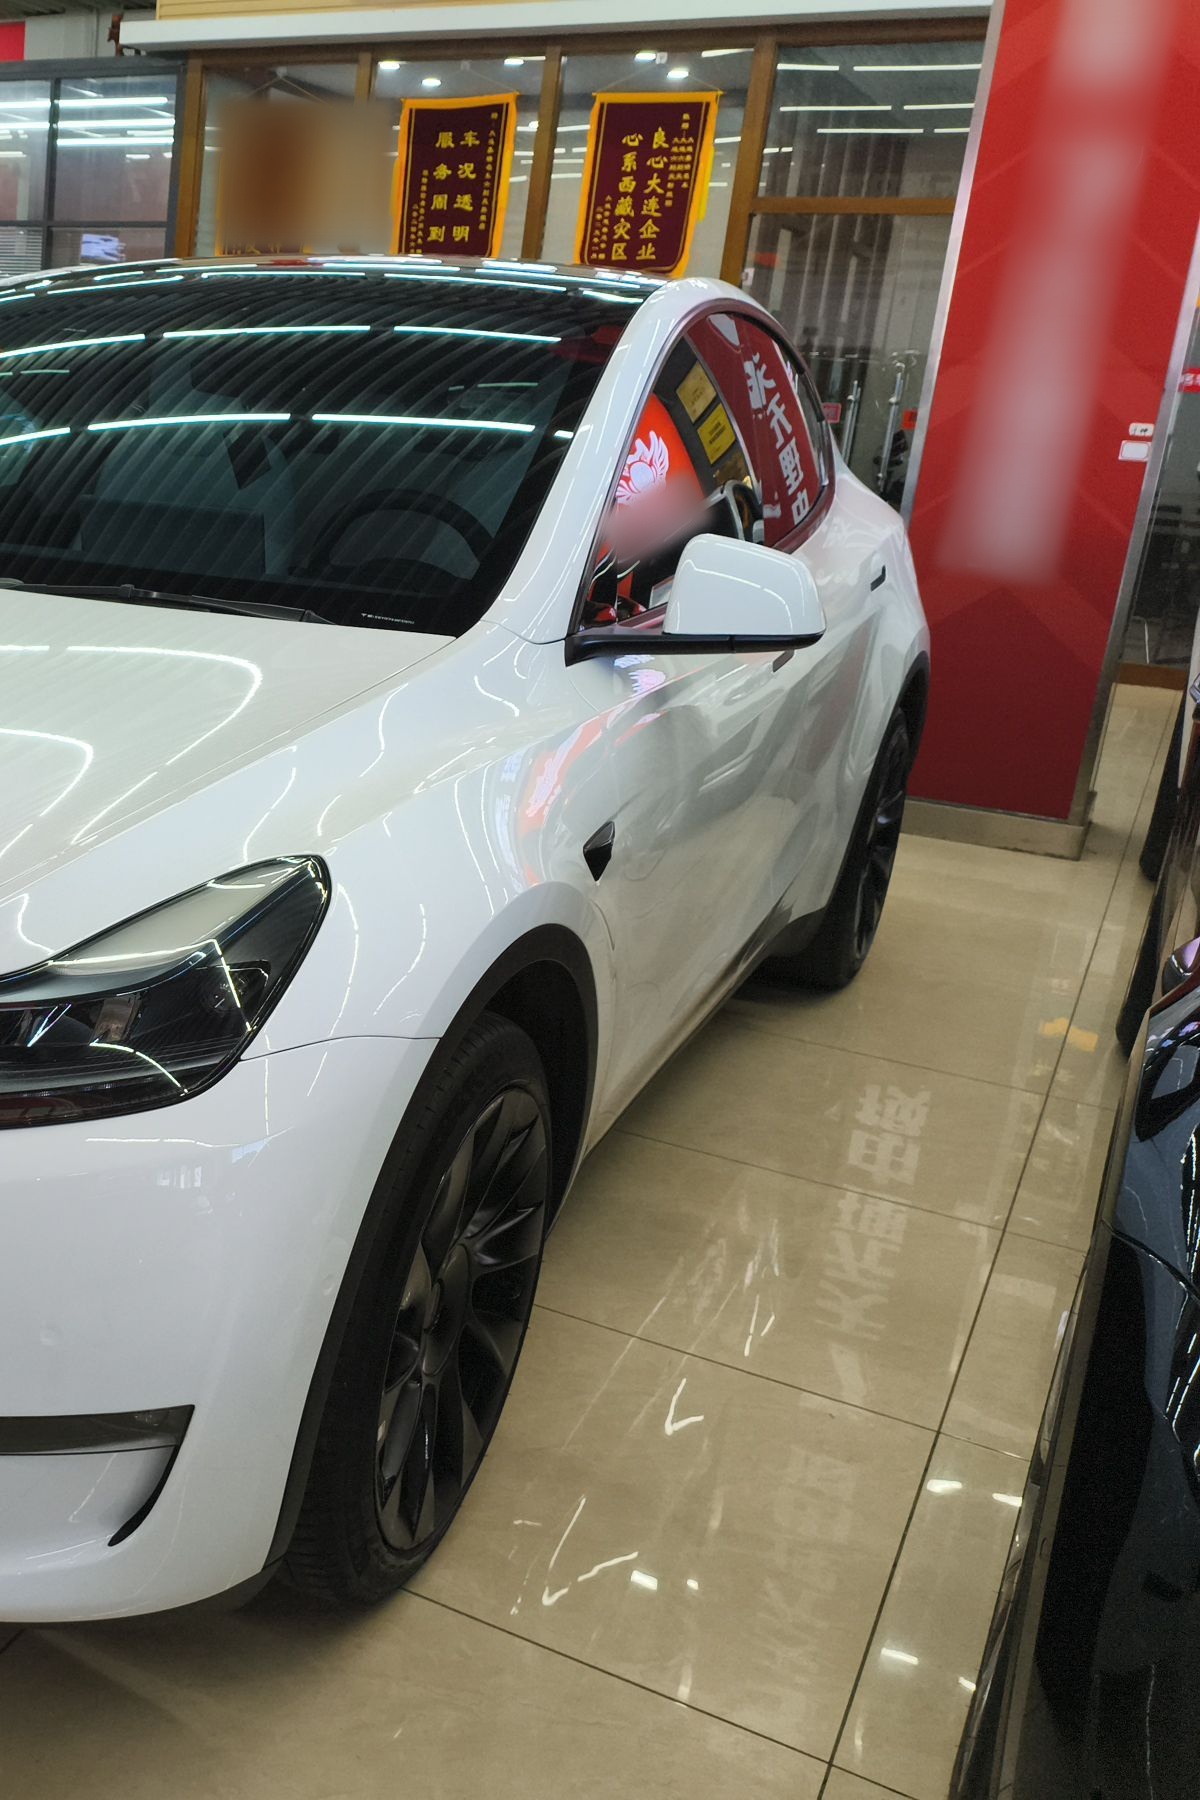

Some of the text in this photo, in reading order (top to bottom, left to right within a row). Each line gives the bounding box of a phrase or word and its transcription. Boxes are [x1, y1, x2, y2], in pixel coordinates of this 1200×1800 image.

[428, 131, 455, 242] 服务周到
[453, 129, 480, 242] 车况透明
[611, 132, 643, 260] 心系西藏灾区
[636, 126, 669, 260] 良心大连企业
